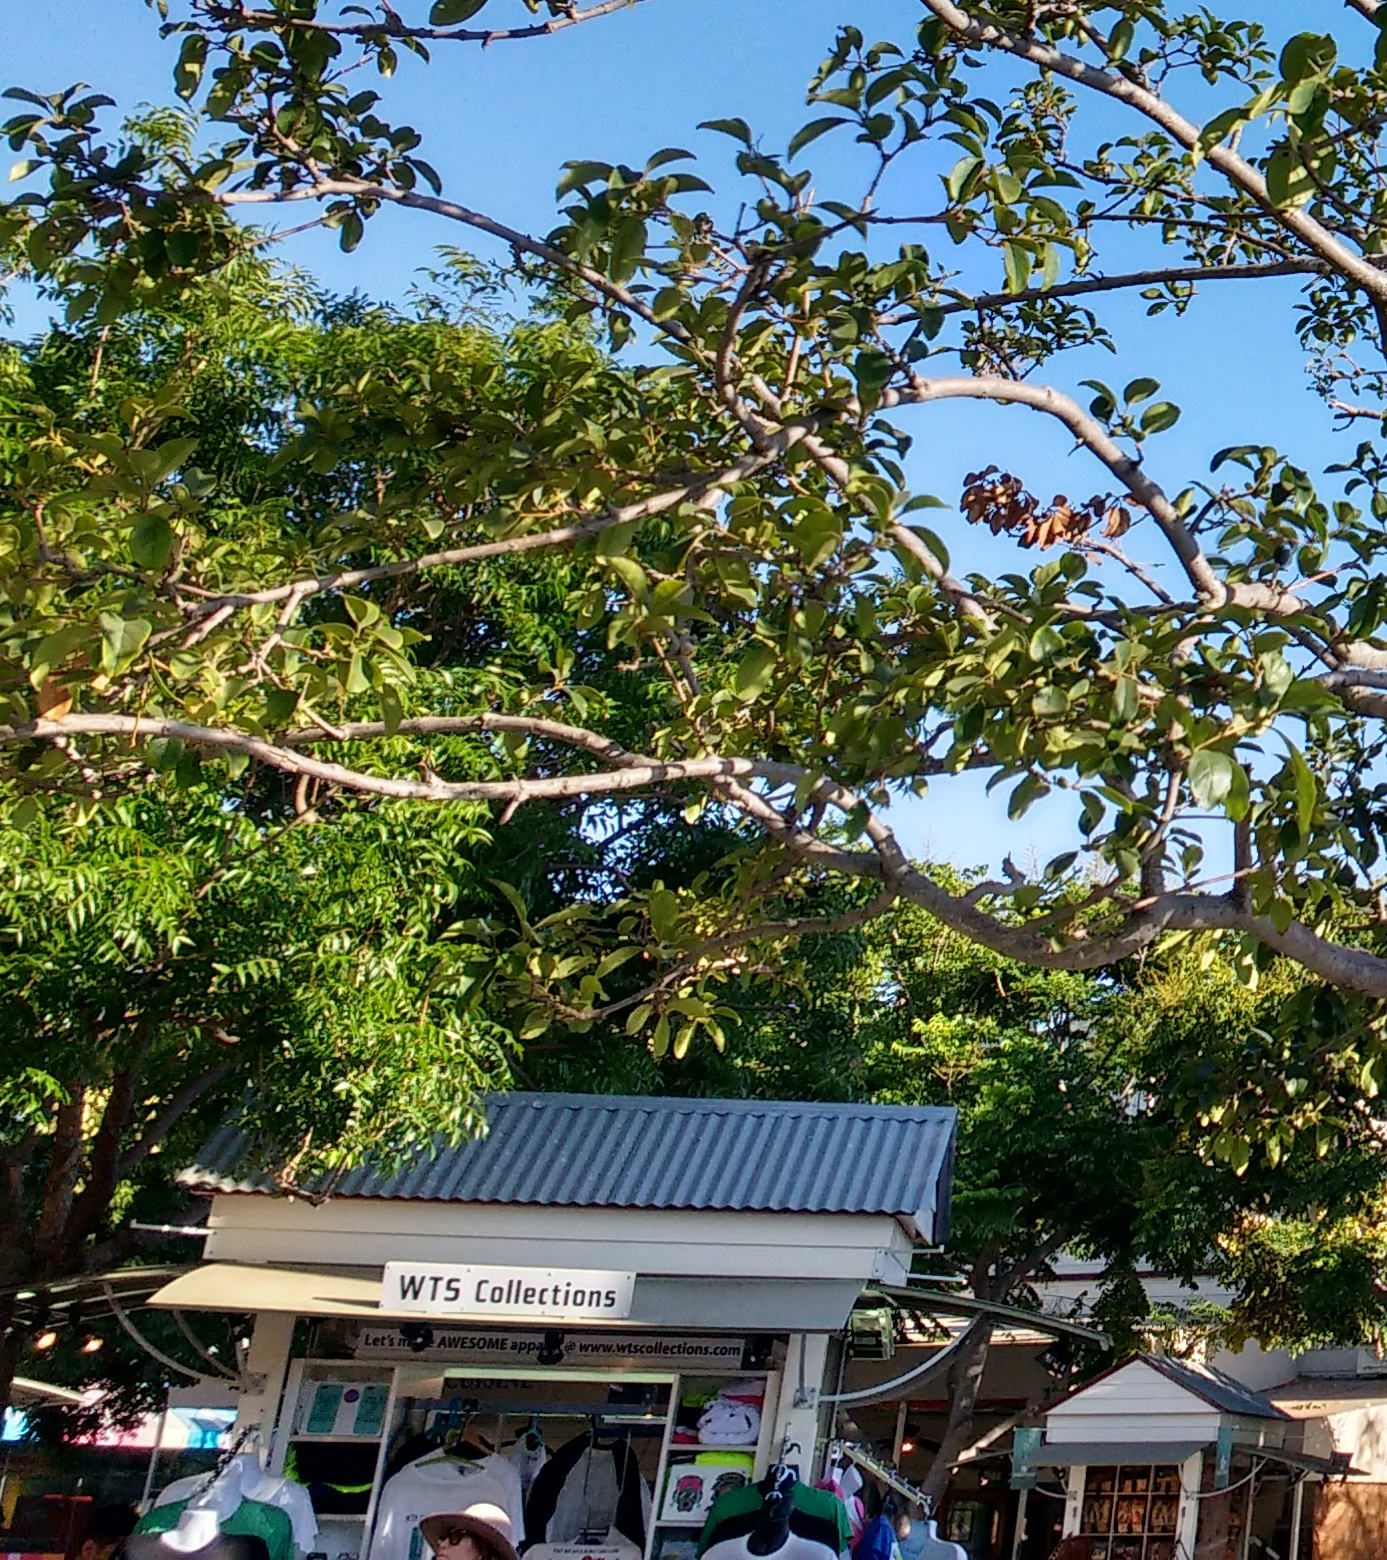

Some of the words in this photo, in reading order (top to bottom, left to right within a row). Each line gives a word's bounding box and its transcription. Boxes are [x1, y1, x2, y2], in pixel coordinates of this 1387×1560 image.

[399, 1274, 461, 1302] WTS
[475, 1279, 617, 1308] Collections
[364, 1333, 395, 1347] Let's
[437, 1336, 508, 1351] AWESOME
[579, 1341, 740, 1357] www.wtscollections.com
